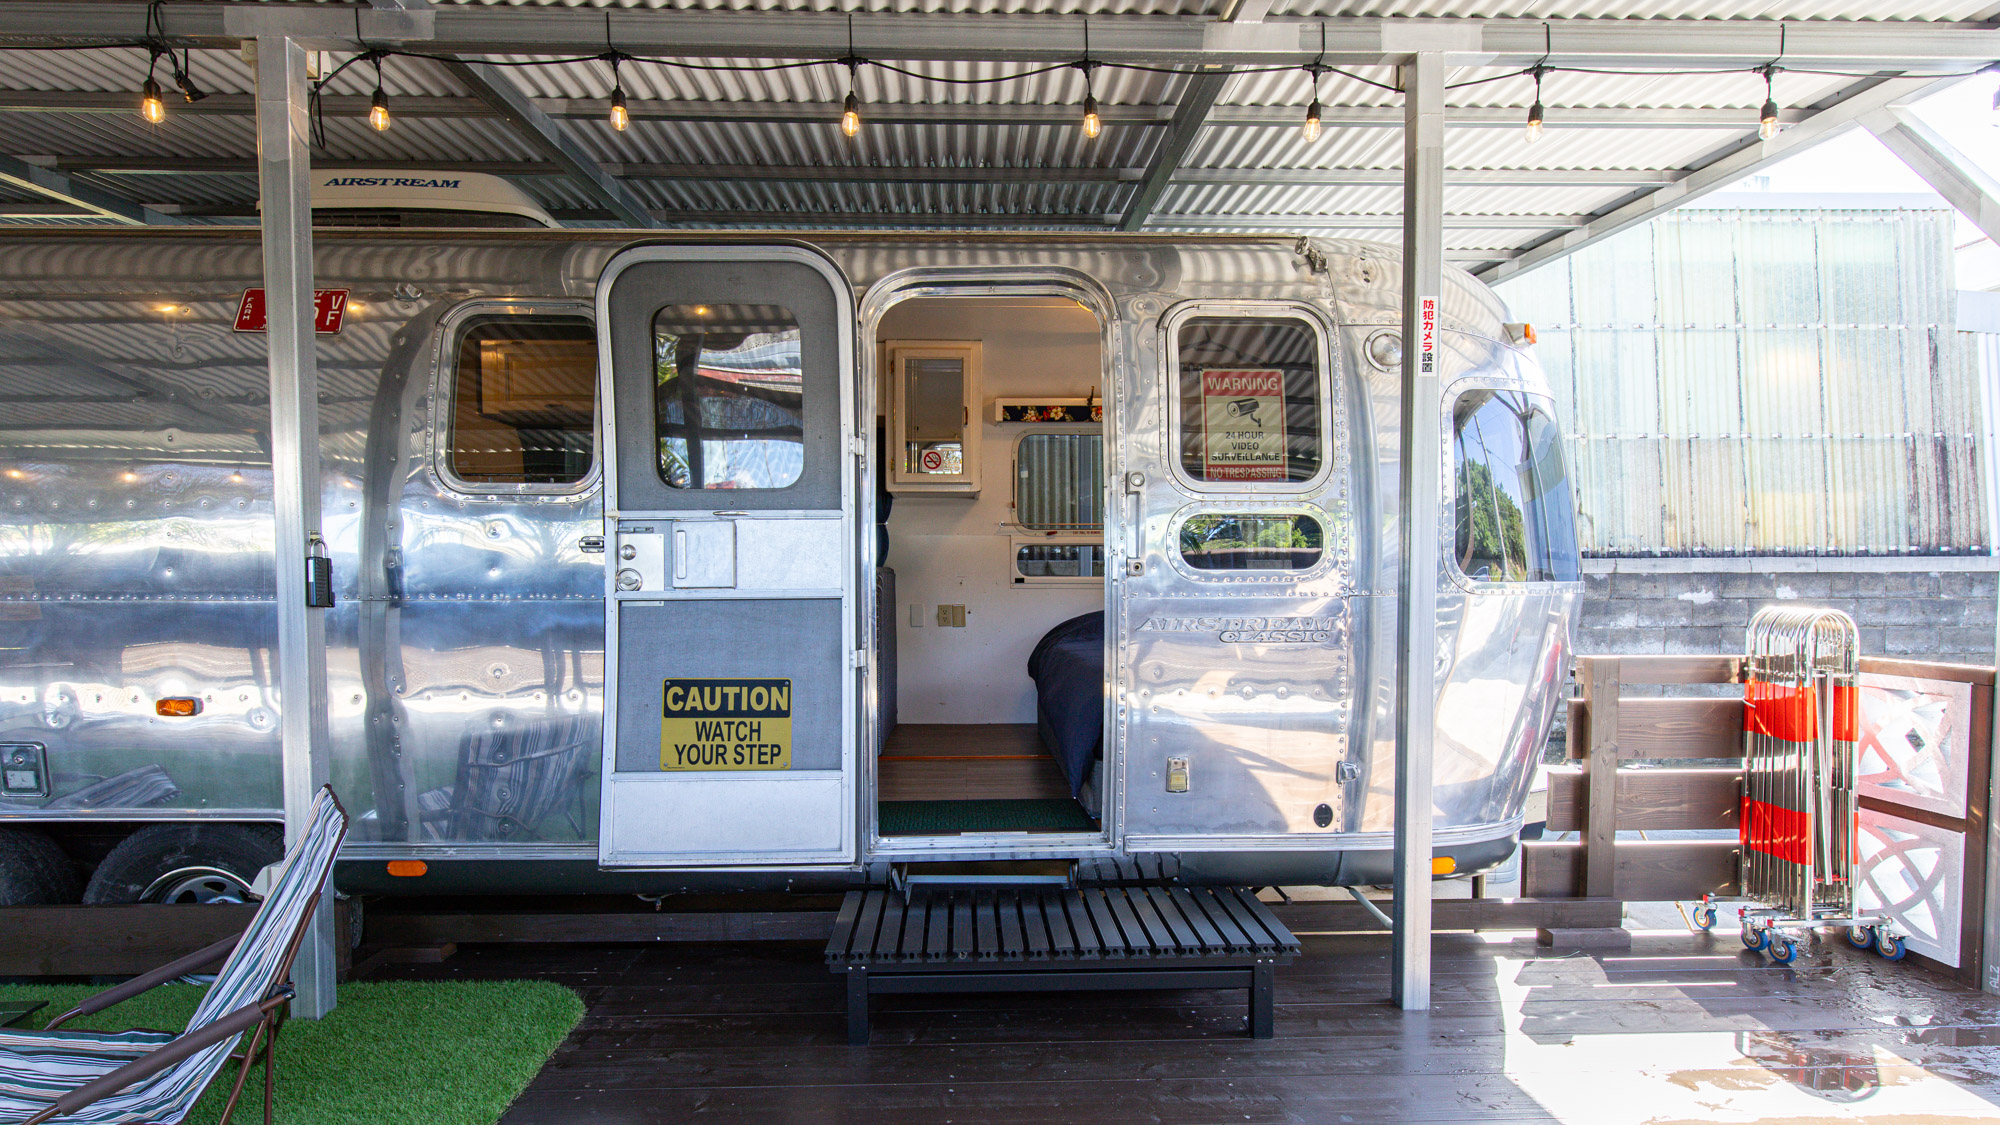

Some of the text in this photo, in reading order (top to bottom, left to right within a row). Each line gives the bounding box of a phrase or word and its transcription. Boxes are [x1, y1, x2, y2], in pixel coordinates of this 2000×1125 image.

[323, 177, 462, 188] AIRSTREAM
[242, 297, 254, 320] FARM
[1421, 299, 1434, 373] 防犯カメラ設置
[1207, 377, 1278, 391] WARNING
[1225, 431, 1264, 440] 24 HOUR
[1231, 442, 1260, 450] VIDEO
[1211, 452, 1280, 461] SURVEILLANCE
[1210, 467, 1282, 478] NO TRESPASSING
[1135, 616, 1340, 632] AIRSTREAM
[1219, 630, 1331, 643] CLASSIC
[666, 686, 789, 711] CAUTION
[695, 720, 761, 742] WATCH
[674, 743, 781, 765] YOUR STEP
